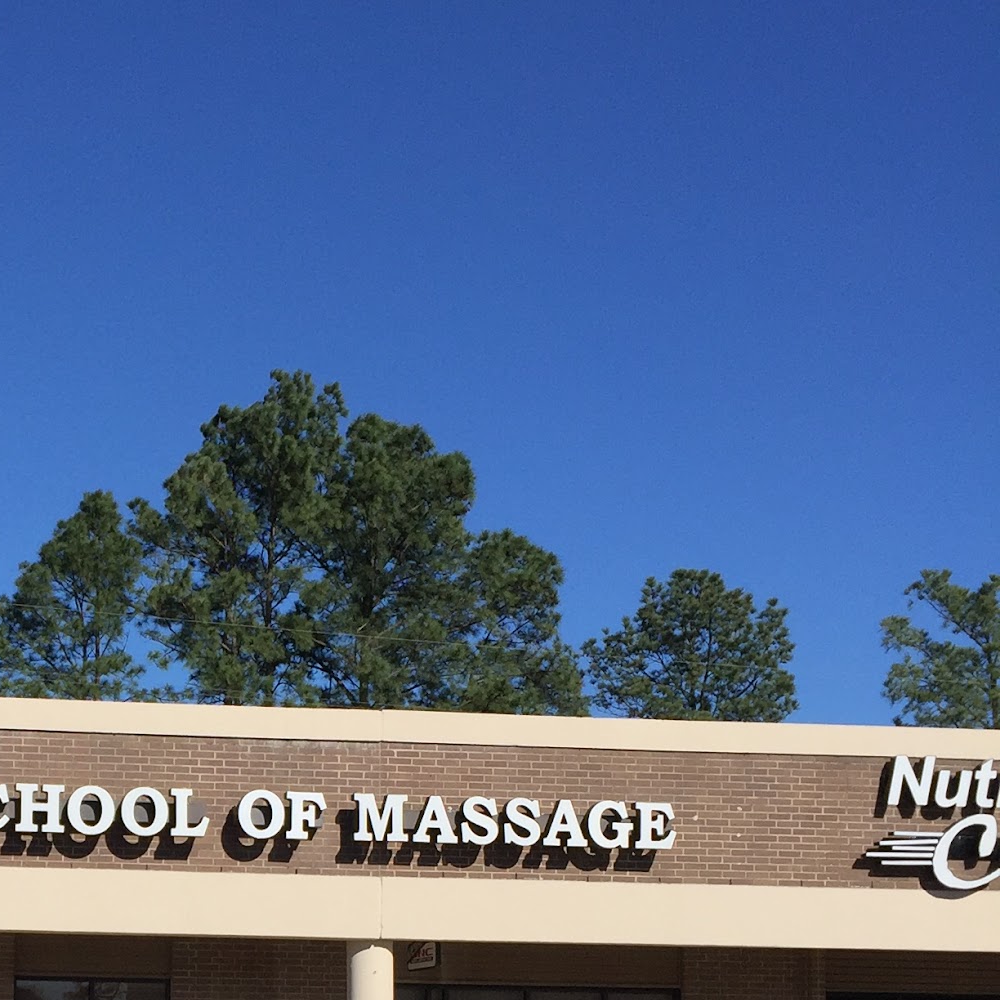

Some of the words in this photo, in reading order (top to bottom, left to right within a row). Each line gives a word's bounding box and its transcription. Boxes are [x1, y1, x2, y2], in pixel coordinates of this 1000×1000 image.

[887, 755, 1000, 808] Nut
[238, 789, 327, 840] OF
[352, 793, 678, 849] MASSAGE
